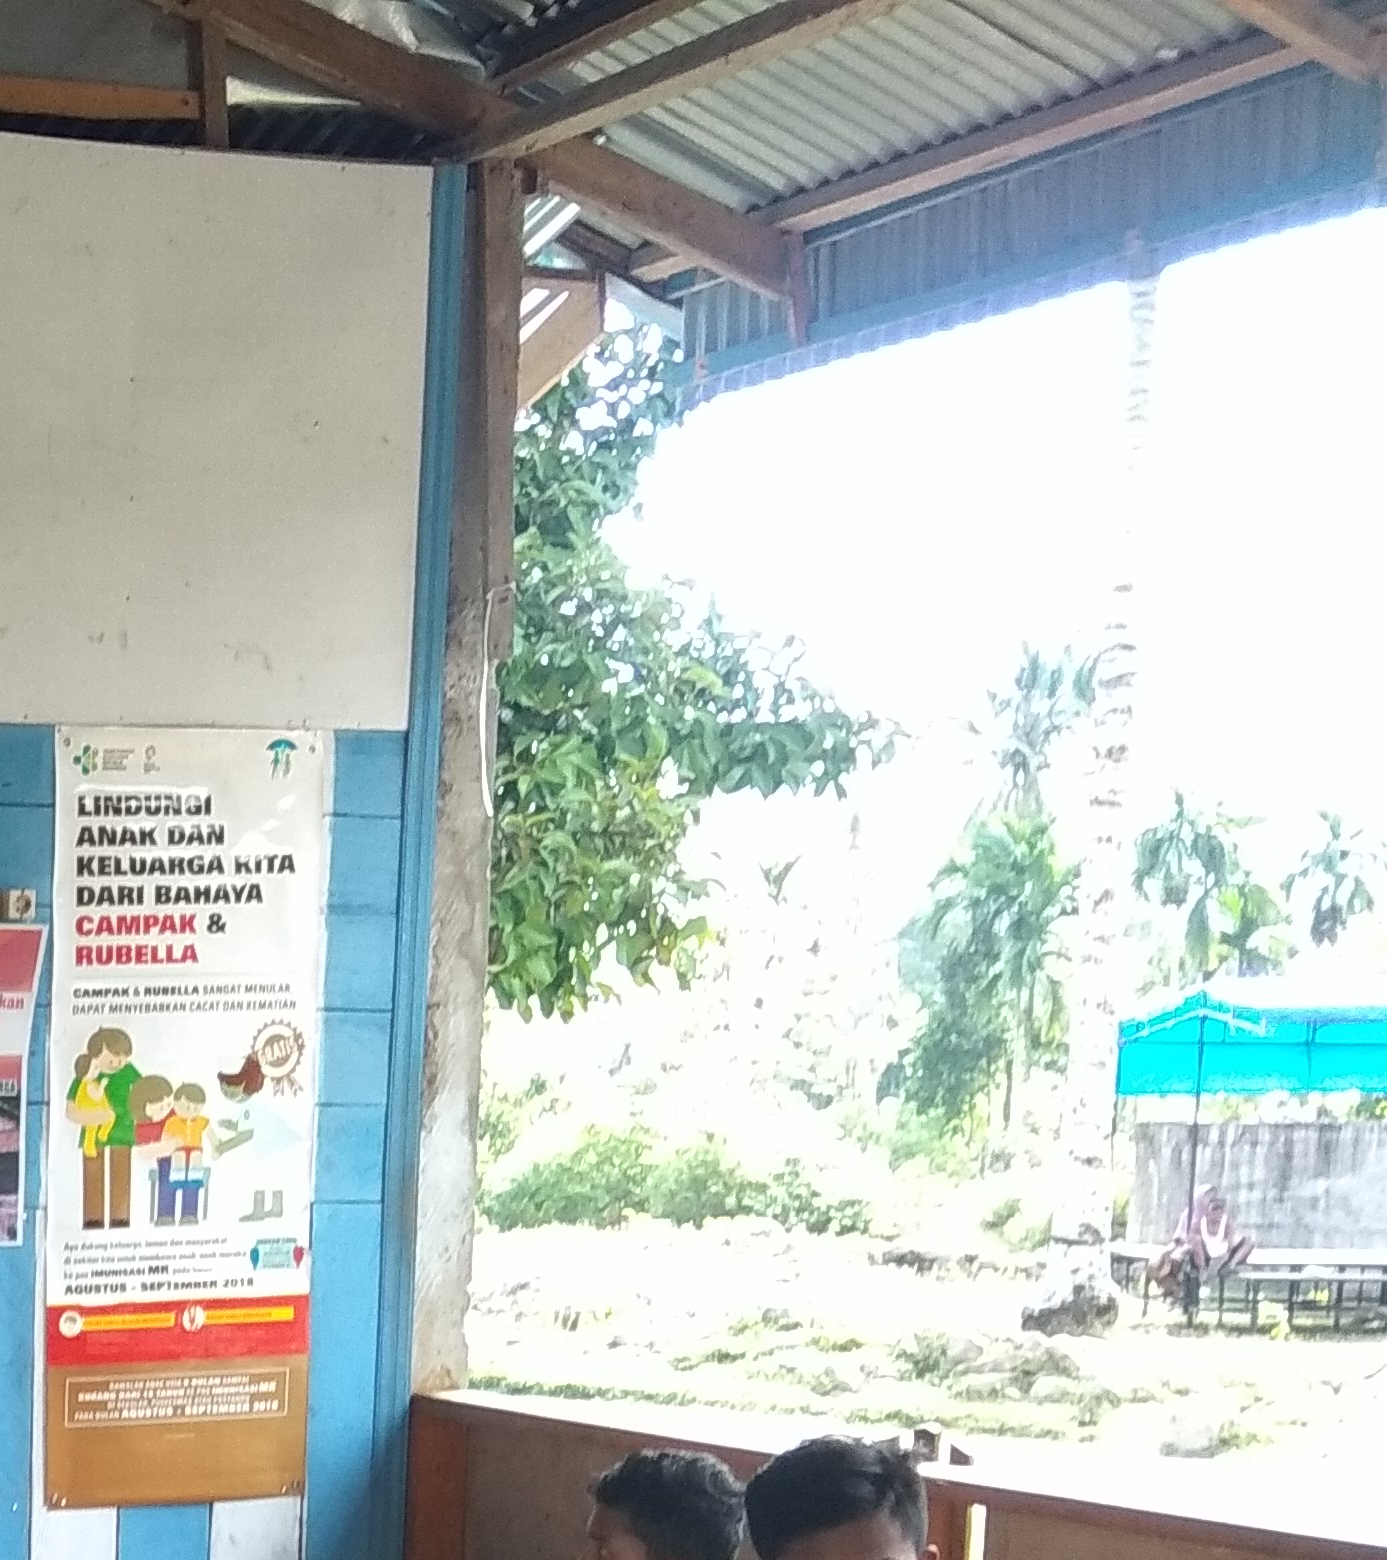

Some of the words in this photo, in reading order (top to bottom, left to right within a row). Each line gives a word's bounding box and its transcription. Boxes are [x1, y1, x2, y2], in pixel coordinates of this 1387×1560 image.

[76, 794, 212, 817] LINDUNGI
[75, 825, 157, 848] ANAK
[166, 824, 225, 846] DAN
[75, 854, 225, 878] KELUARGA
[233, 853, 296, 875] KITA
[75, 885, 145, 907] DARI
[154, 882, 264, 906] BAHAYA
[74, 913, 198, 937] CAMPAK
[206, 912, 227, 934] &
[75, 943, 199, 967] RUBELLA
[72, 986, 130, 999] CAMPAK
[64, 1281, 127, 1296] AGUSTUS
